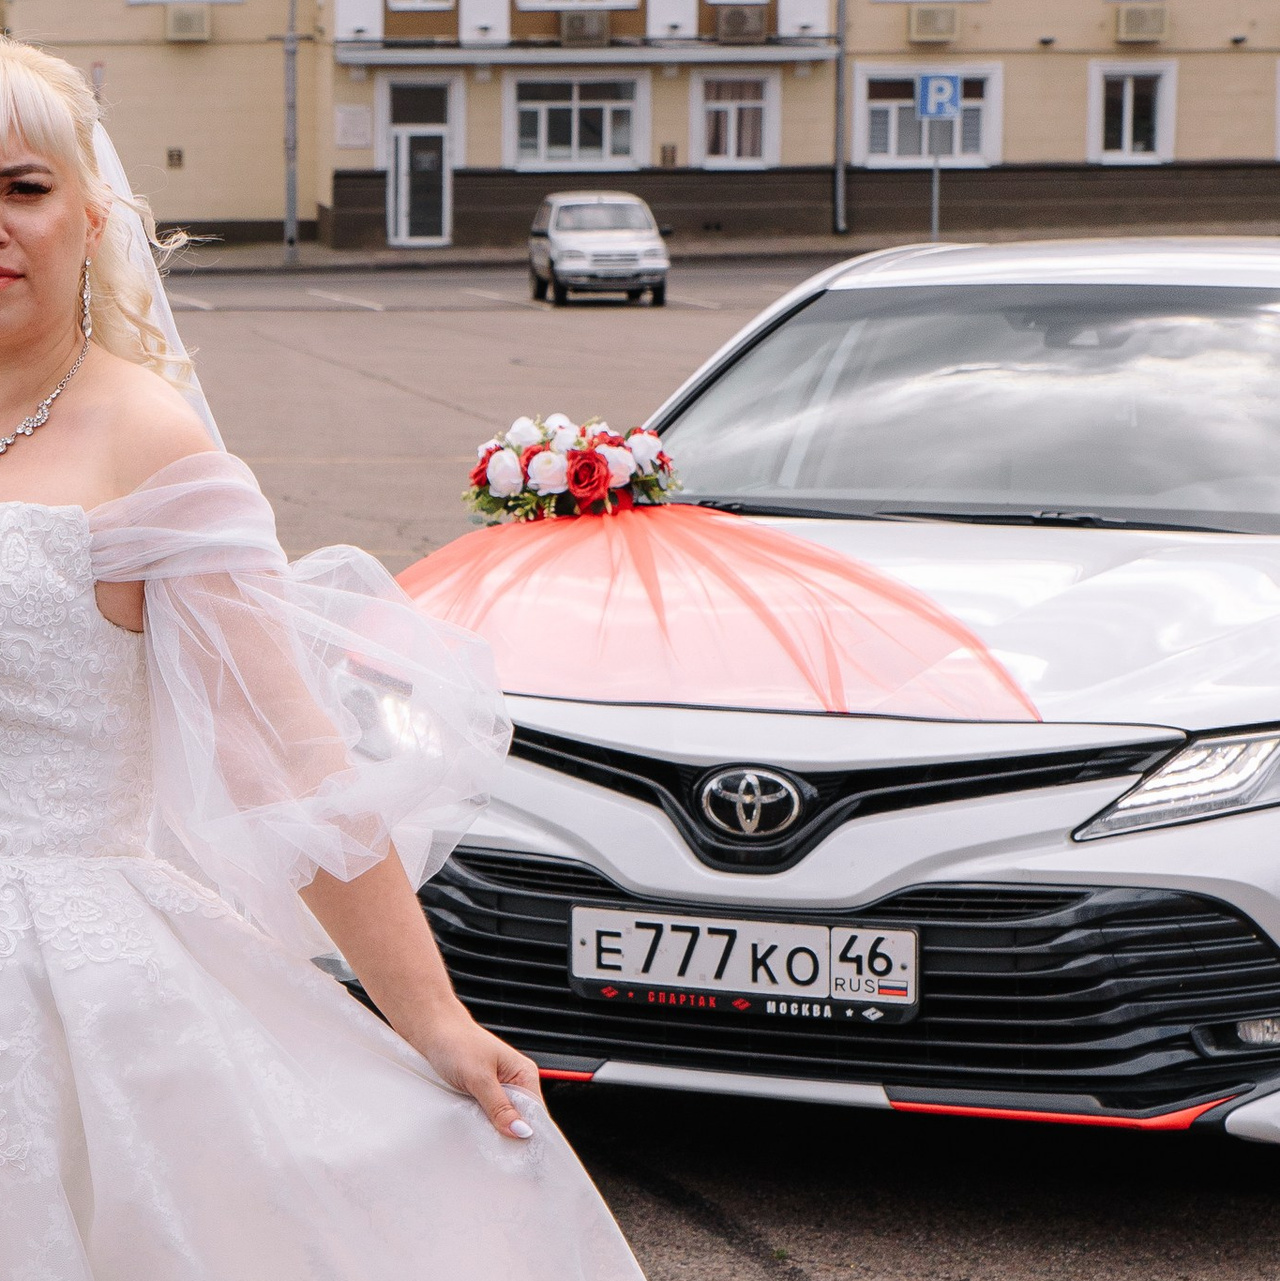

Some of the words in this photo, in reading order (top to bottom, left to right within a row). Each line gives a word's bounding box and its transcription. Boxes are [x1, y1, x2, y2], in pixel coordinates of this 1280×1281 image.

[838, 934, 894, 977] 46
[834, 977, 876, 995] RUS
[647, 991, 717, 1008] СПАРТАК
[766, 1000, 832, 1018] МОСКВА
